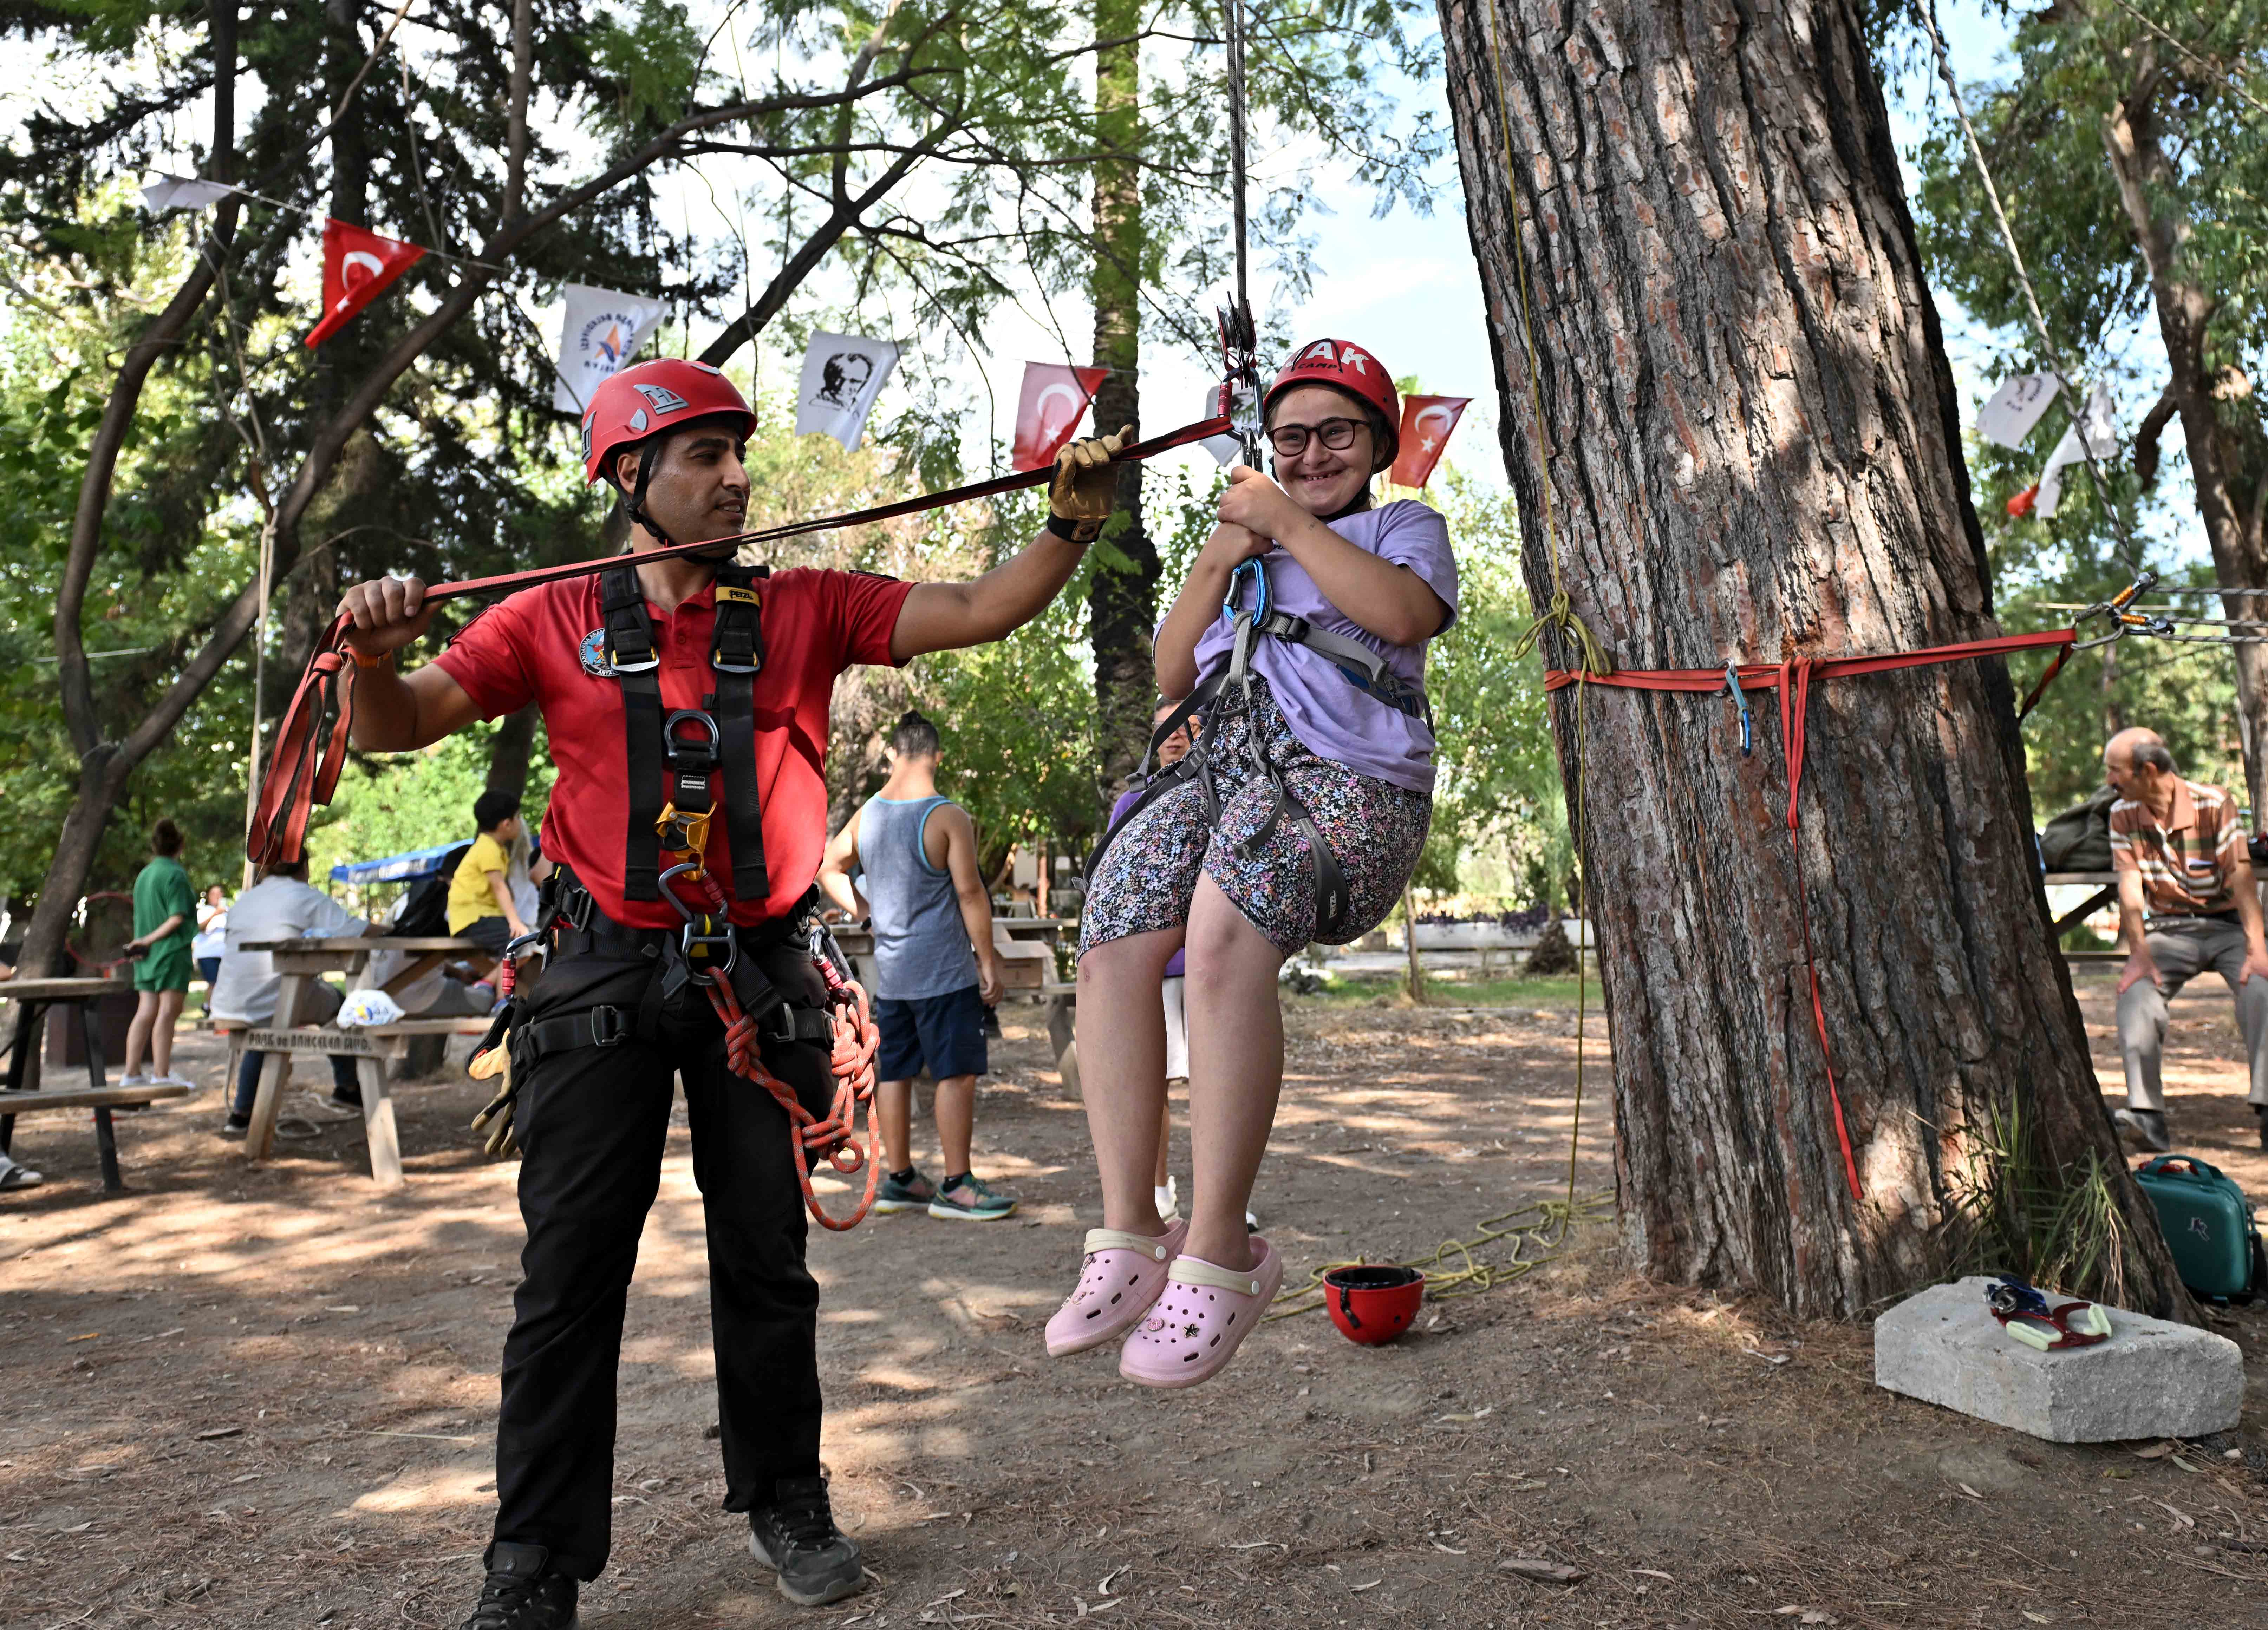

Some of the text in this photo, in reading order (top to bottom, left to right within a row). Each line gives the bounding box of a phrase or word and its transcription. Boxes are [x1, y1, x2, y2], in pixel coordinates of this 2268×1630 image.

[730, 590, 754, 600] PETZL
[581, 637, 591, 666] JANDARMA
[1328, 890, 1337, 919] PETZL
